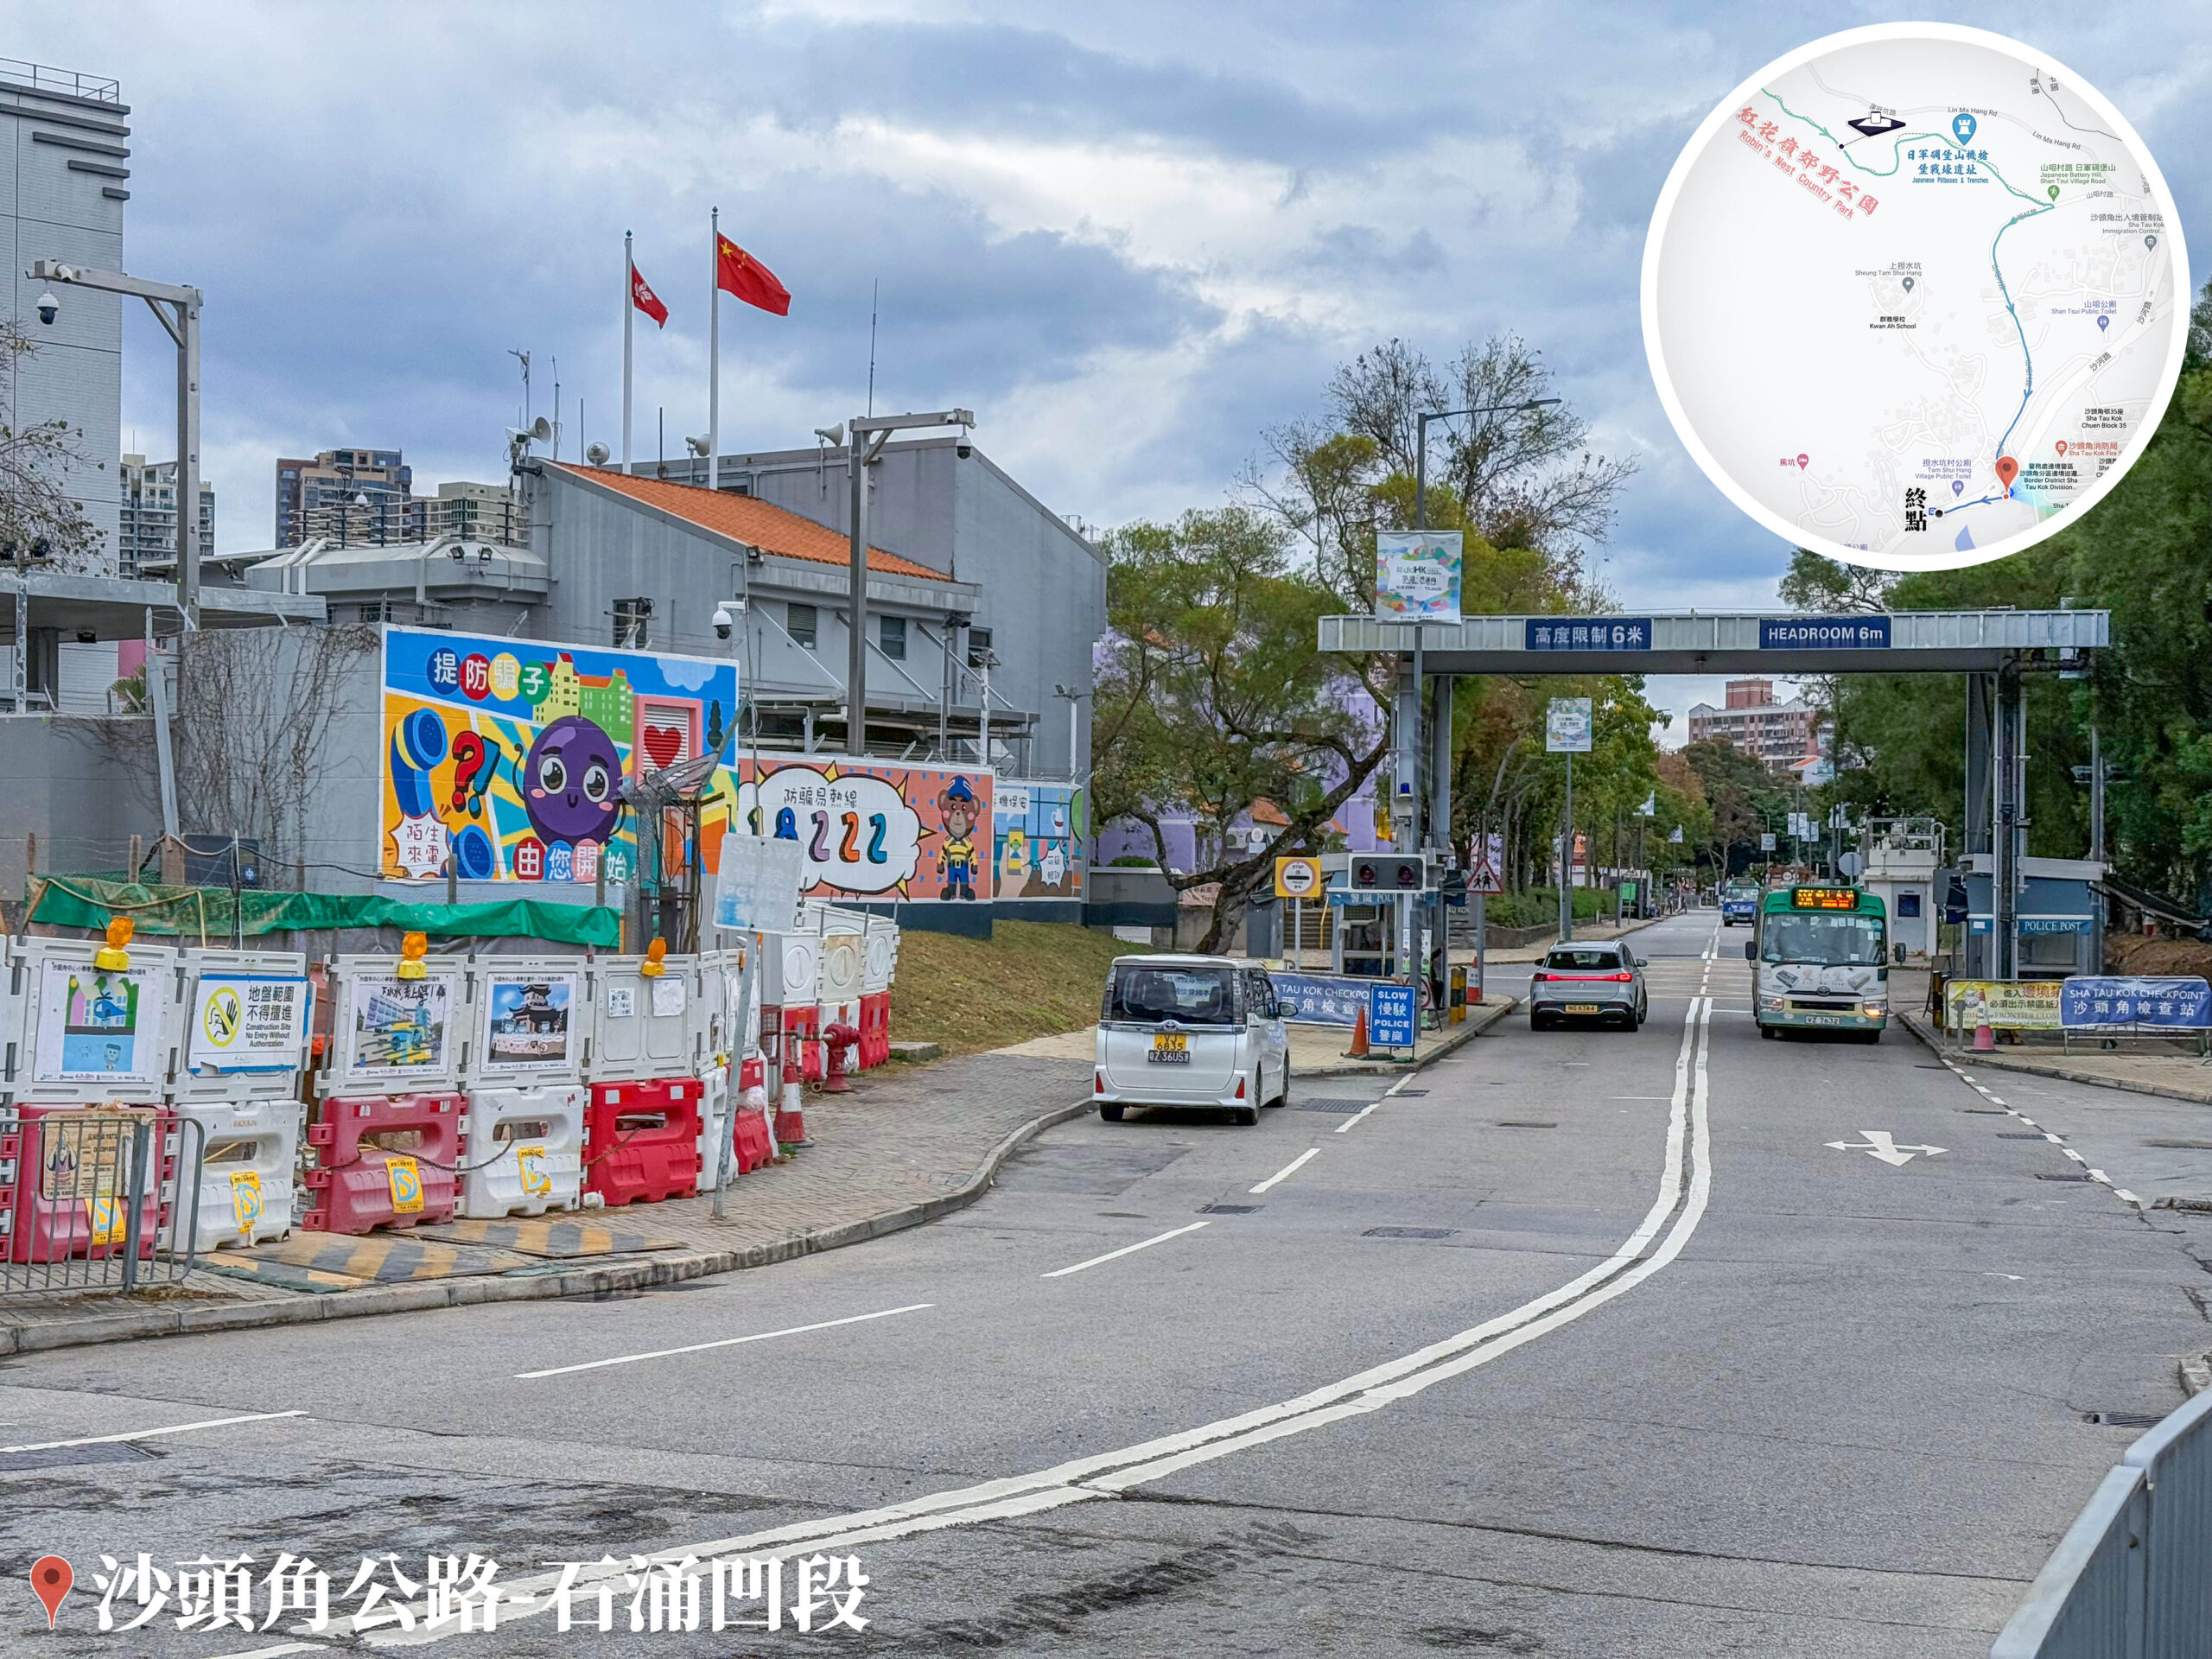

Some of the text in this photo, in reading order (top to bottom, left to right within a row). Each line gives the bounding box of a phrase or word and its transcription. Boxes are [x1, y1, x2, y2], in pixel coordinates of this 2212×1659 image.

[1769, 626, 1884, 640] HEADROOM 6m
[434, 652, 544, 695] 提防騙子
[784, 786, 858, 809] 防騙易熱線
[994, 793, 1027, 809] 機保安
[407, 823, 440, 842] 陌生
[408, 845, 440, 864] 來電
[518, 842, 627, 881] 由您開始
[2024, 920, 2082, 931] POLICE POST
[248, 985, 295, 1003] 地盤範圍
[1281, 984, 1300, 994] TAU
[1303, 986, 1322, 995] KOK
[1325, 988, 1370, 1000] CHECKPO
[1377, 990, 1408, 1001] SLOW
[2069, 988, 2206, 1001] SHA TAU KOK CHECKPOINT
[1377, 1001, 1407, 1017] 慢駛
[2073, 1000, 2196, 1017] 沙頭角檢查站
[280, 1022, 292, 1031] Site
[1374, 1019, 1410, 1028] POLICE
[254, 1032, 269, 1040] Entry
[1378, 1029, 1403, 1043] 警崗
[1156, 1041, 1184, 1051] 6835
